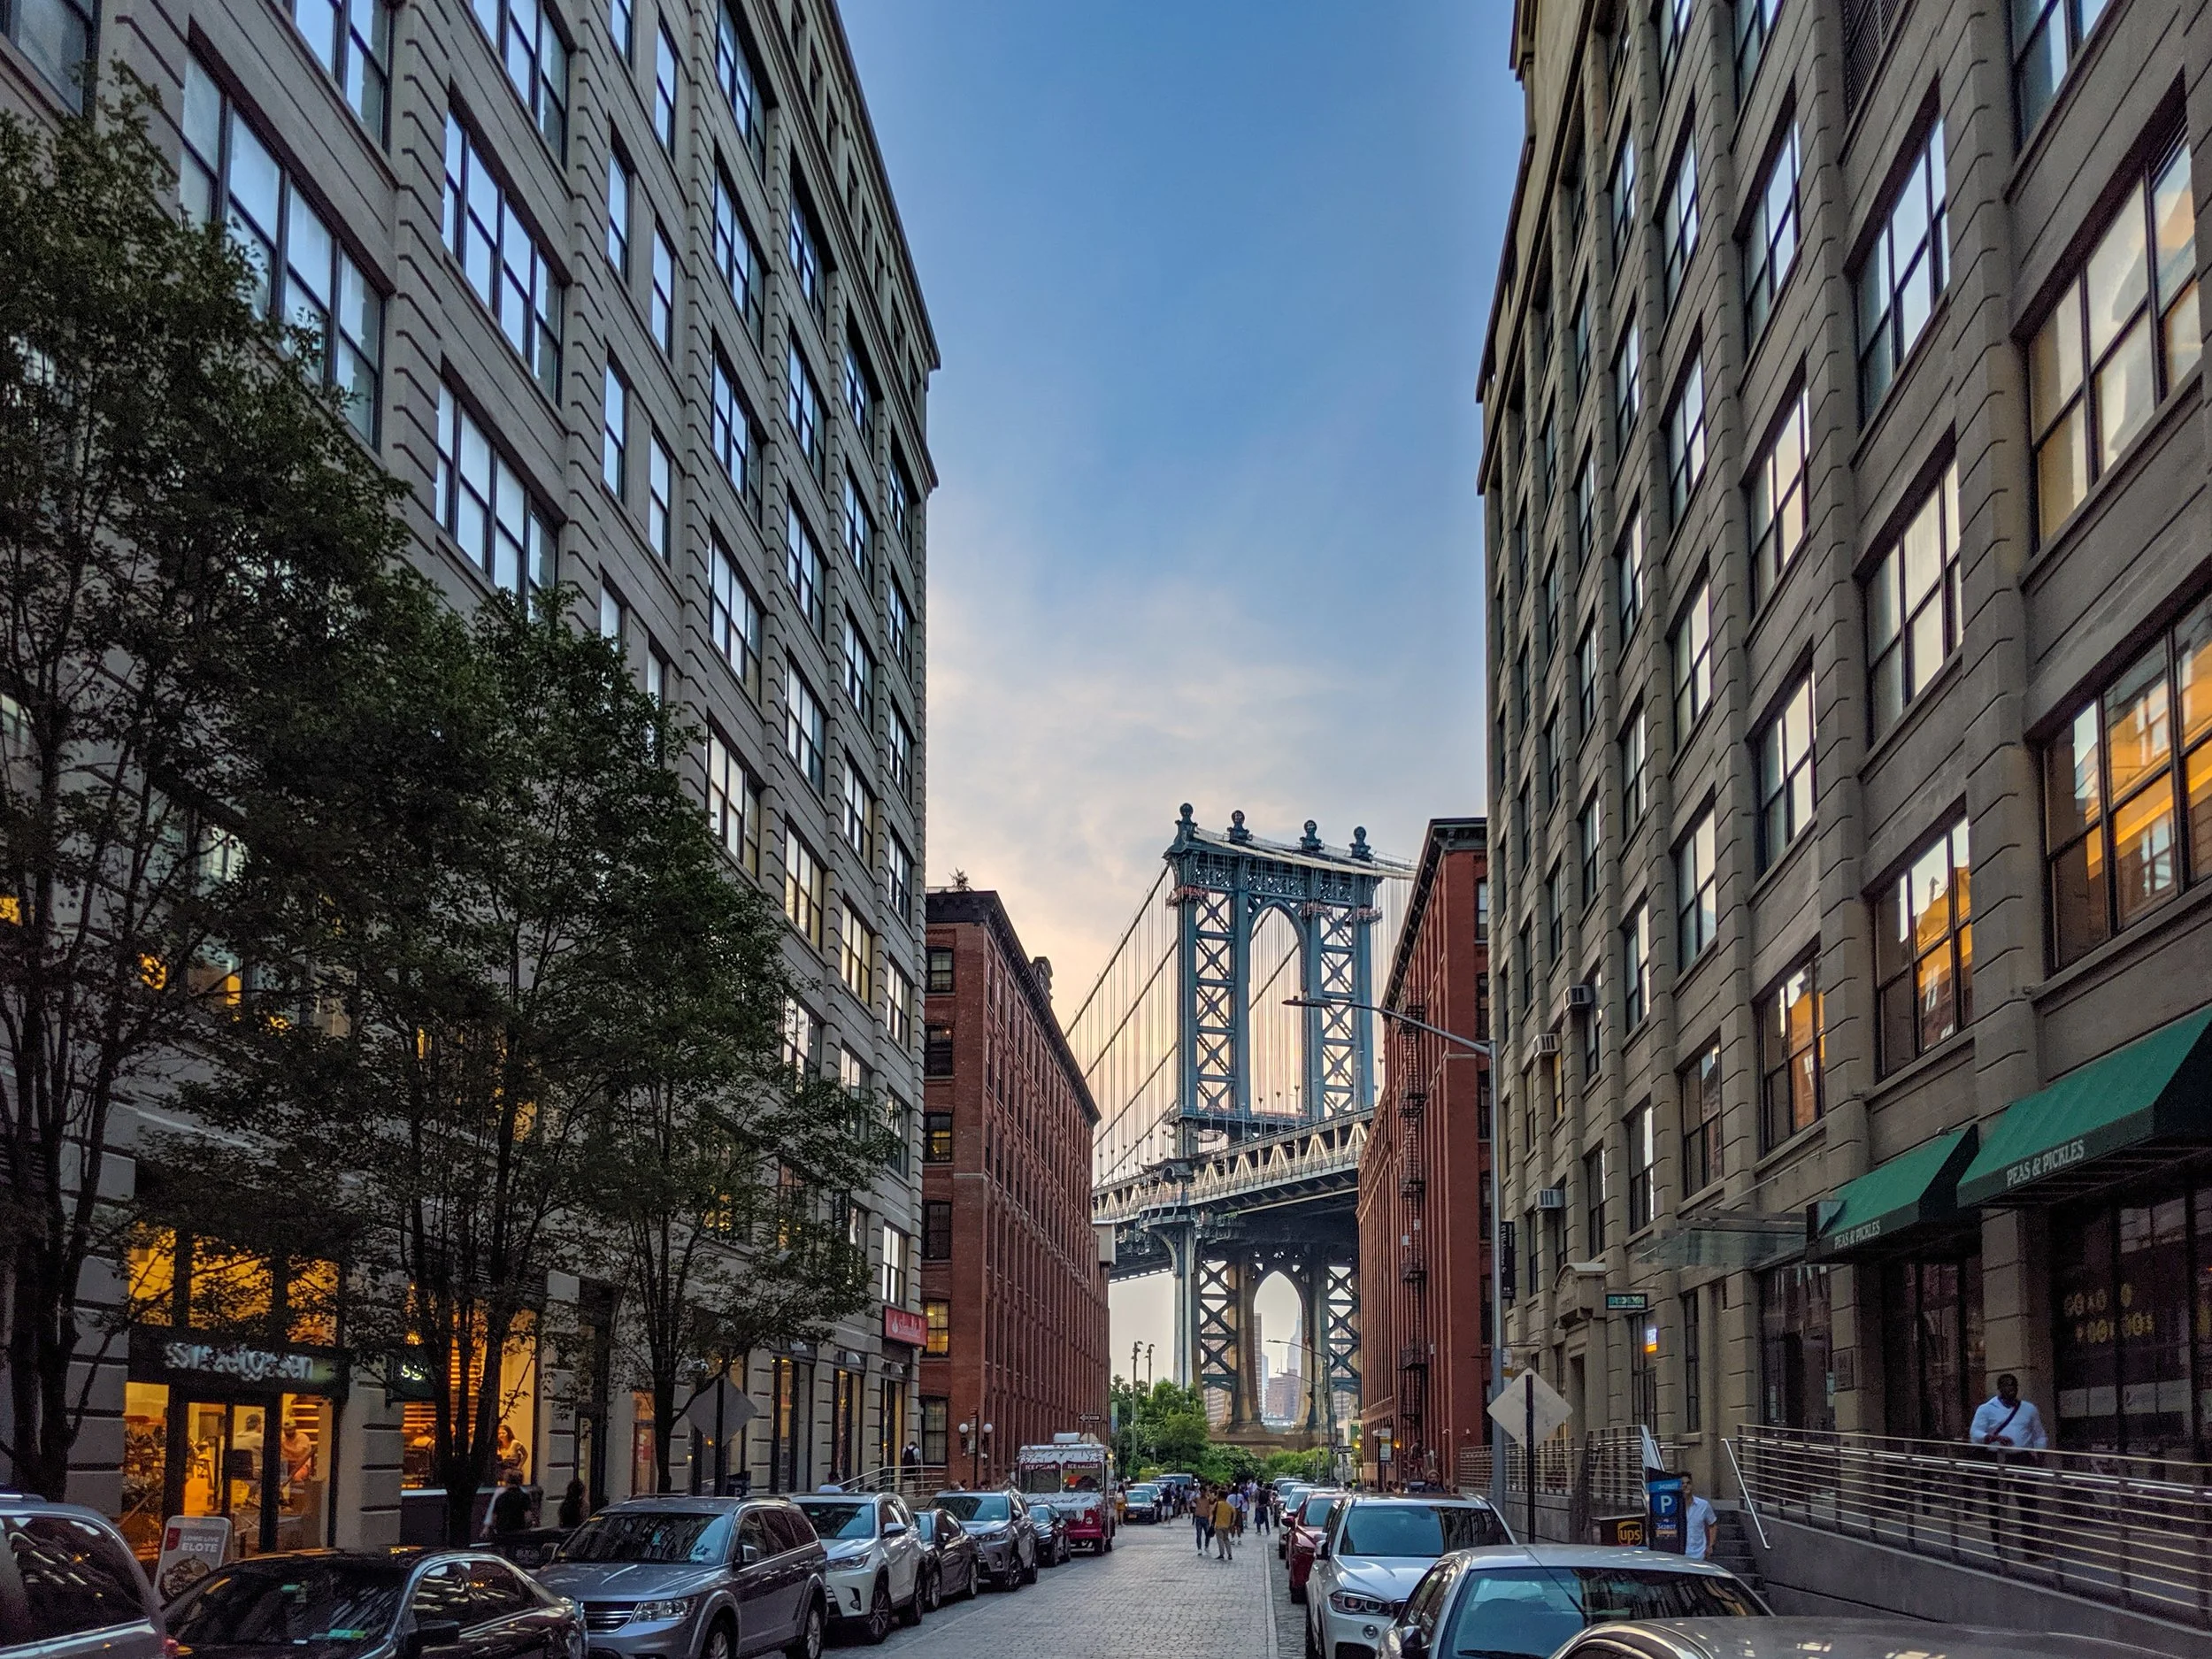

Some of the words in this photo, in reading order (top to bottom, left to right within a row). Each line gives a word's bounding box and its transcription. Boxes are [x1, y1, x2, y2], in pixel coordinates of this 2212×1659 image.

[2006, 1162, 2031, 1187] PEAS
[2032, 1157, 2041, 1176] &
[2042, 1139, 2085, 1173] PICKLES
[1661, 1495, 1672, 1513] P
[1620, 1530, 1640, 1546] ups
[181, 1543, 219, 1553] ELOTE
